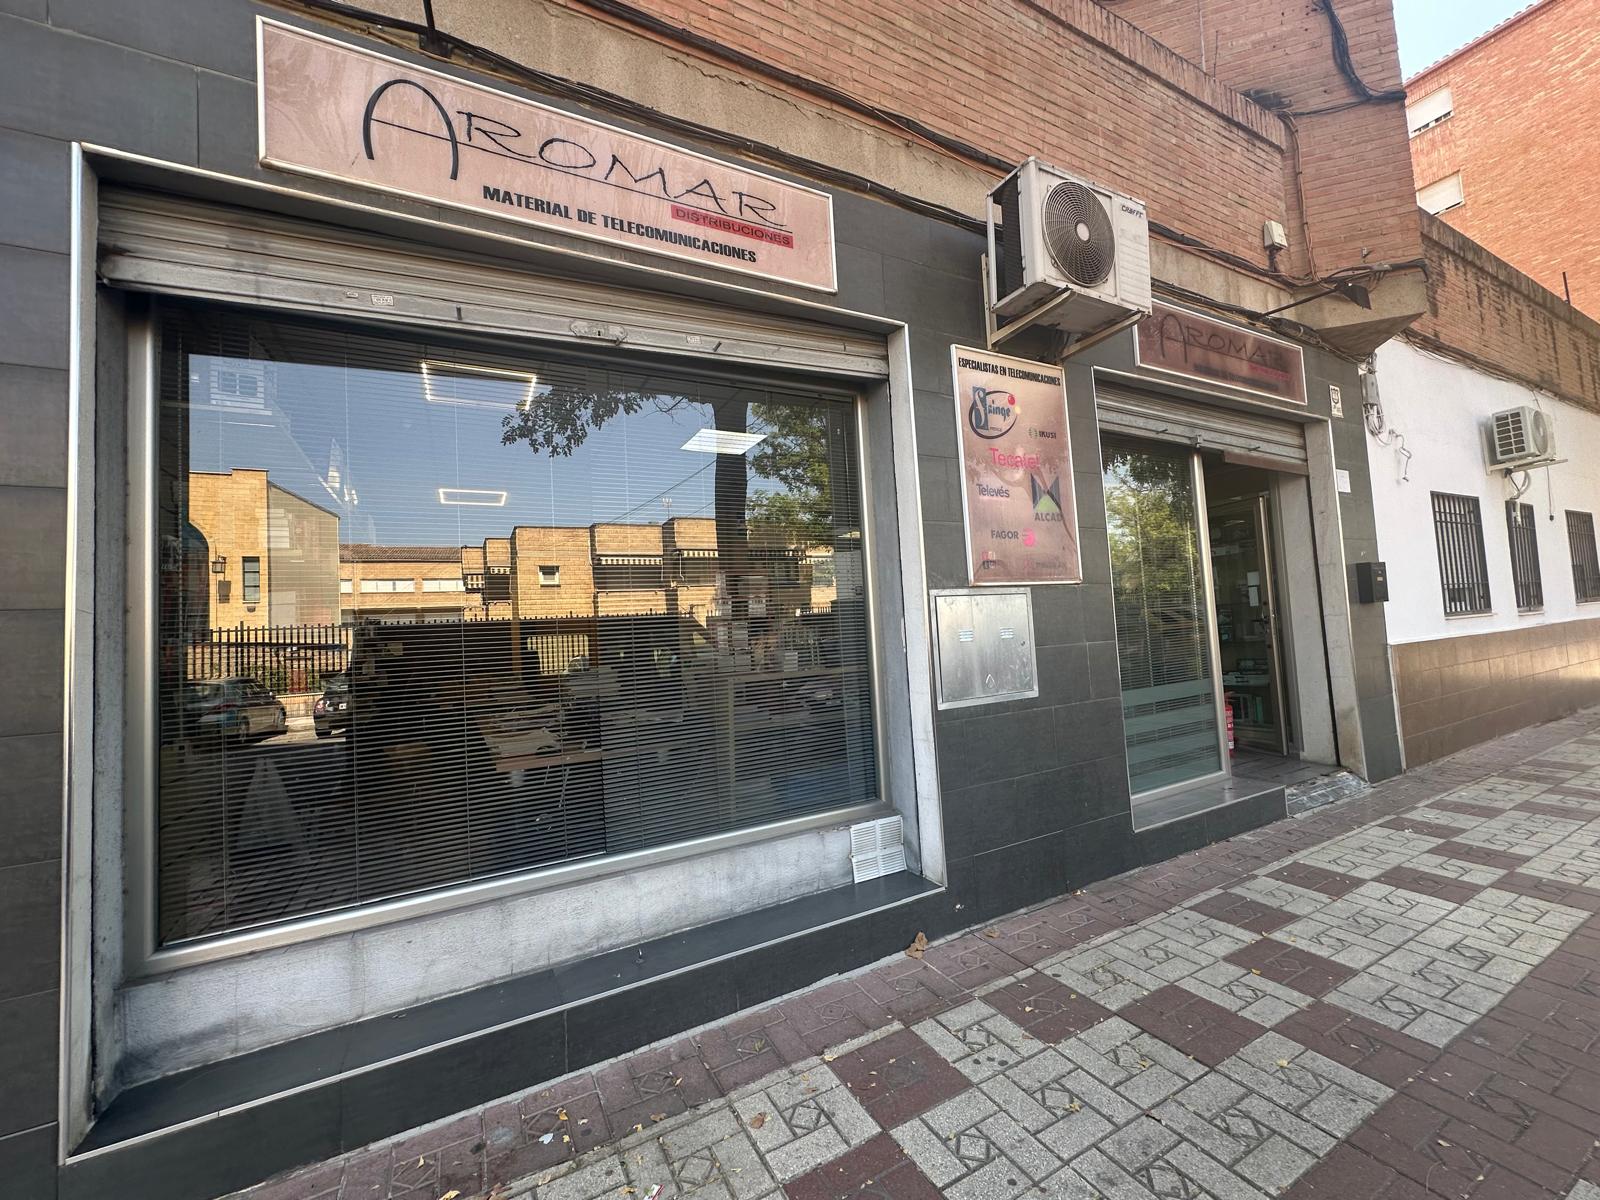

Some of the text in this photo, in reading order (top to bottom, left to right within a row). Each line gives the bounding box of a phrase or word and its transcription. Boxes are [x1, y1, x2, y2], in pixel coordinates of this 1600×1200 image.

[362, 78, 791, 228] AROMAR
[482, 185, 758, 264] MATERIAL DE TELECOMUNICACIONES
[675, 208, 791, 246] DISTRIBUCIONES
[958, 357, 1061, 386] ESPECIALISTAS EN TELECOMUNICACIONES
[976, 483, 1010, 498] Televés
[1034, 512, 1063, 522] ALCAD
[991, 529, 1019, 540] FAGOR
